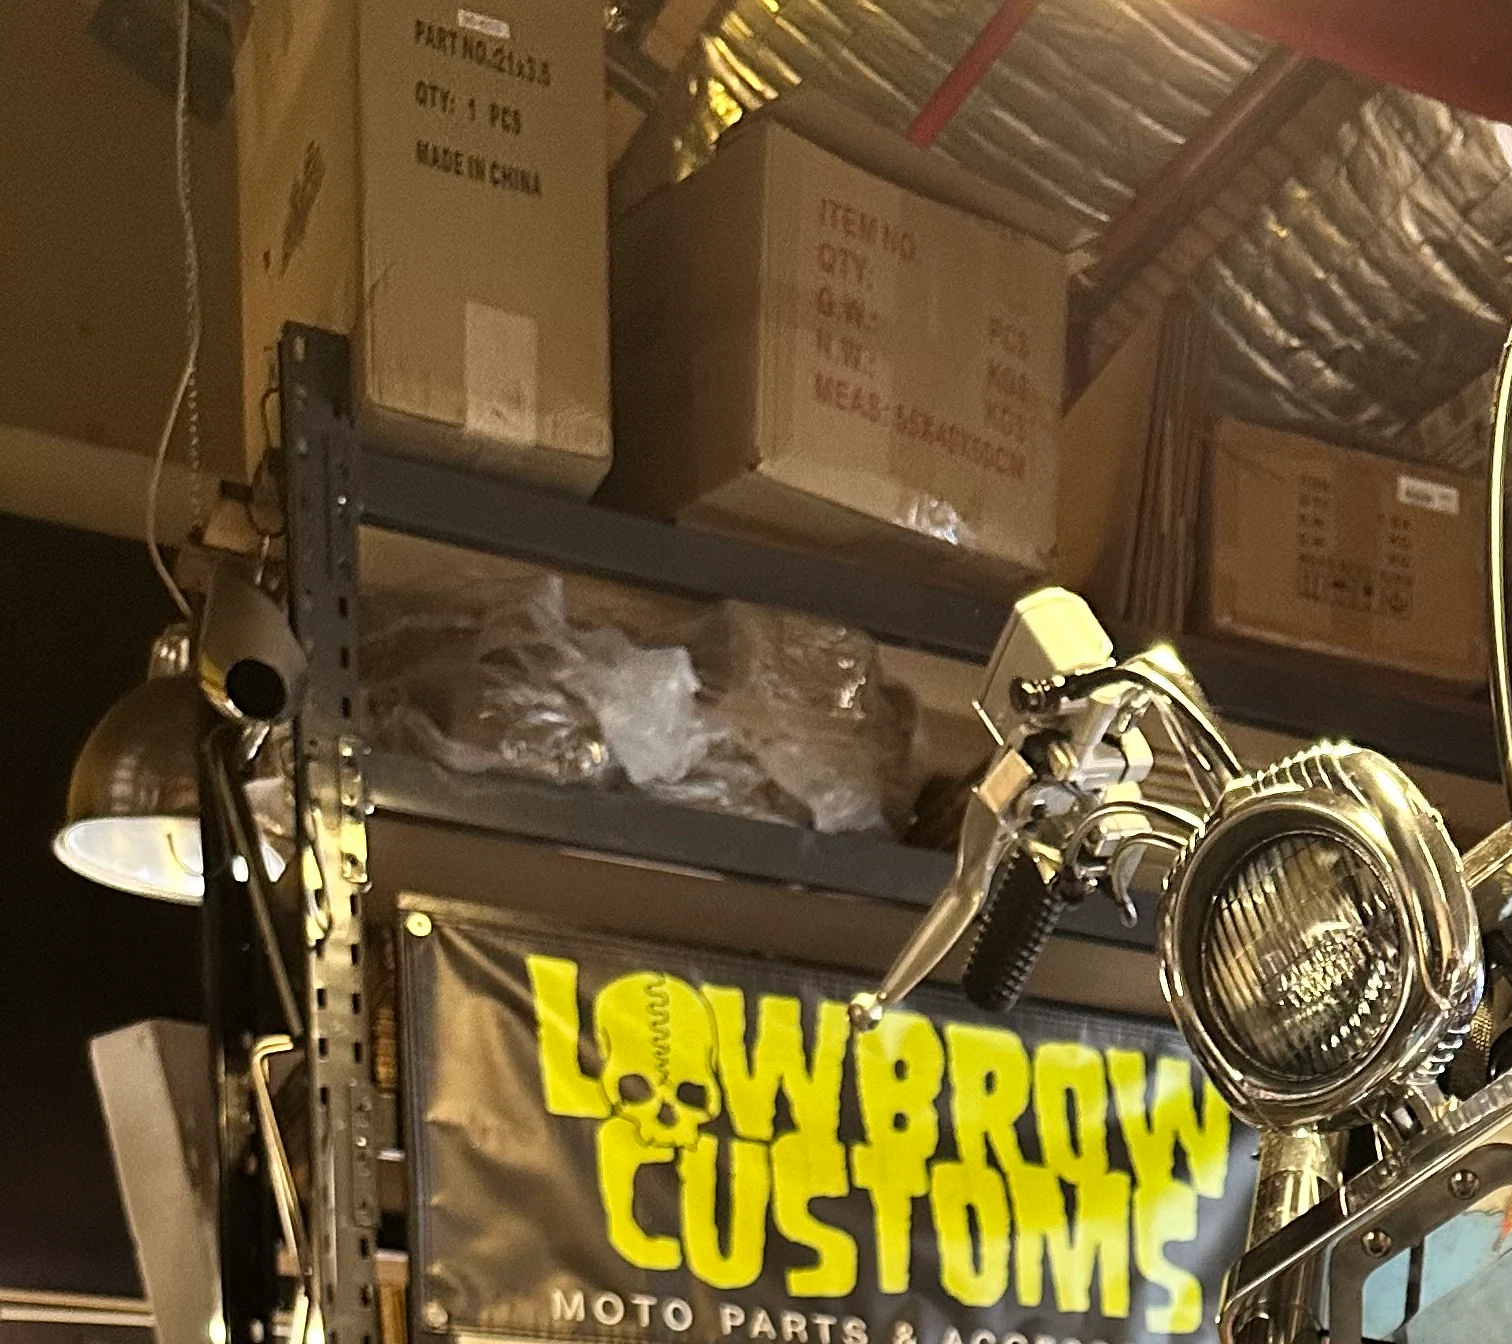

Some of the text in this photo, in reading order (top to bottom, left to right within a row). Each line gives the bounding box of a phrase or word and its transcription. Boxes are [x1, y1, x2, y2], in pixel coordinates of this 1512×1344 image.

[414, 19, 458, 56] PART
[488, 102, 522, 136] PCS
[415, 139, 543, 197] MADE IN CHINA
[816, 196, 879, 243] ITEM
[524, 953, 1235, 1201] LOWBROW
[596, 1113, 1206, 1336] CUSTOMS
[550, 1289, 693, 1332] MOTO
